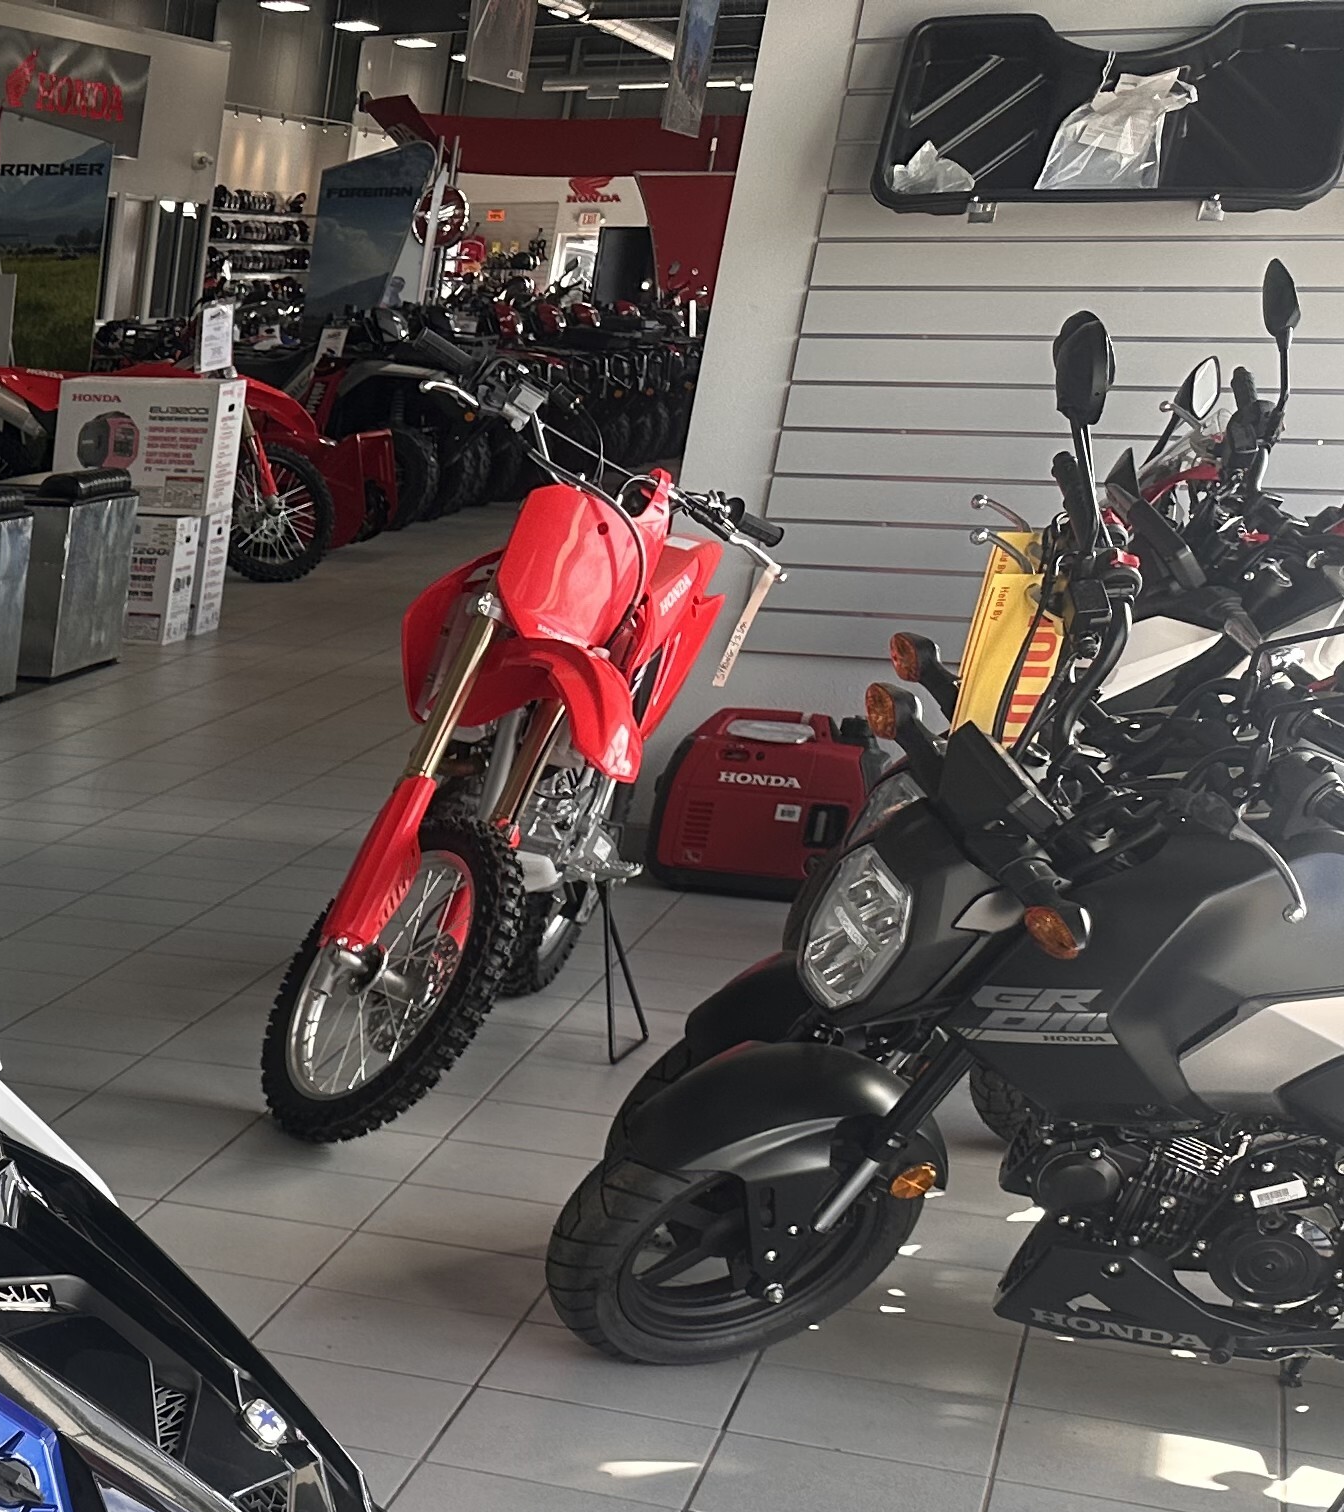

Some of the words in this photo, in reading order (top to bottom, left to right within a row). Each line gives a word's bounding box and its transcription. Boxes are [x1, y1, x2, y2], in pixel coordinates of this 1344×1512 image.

[35, 72, 125, 122] HONDA
[0, 162, 105, 177] RANCHER
[326, 186, 412, 199] FOREMAN
[566, 195, 621, 203] HONDA
[72, 393, 121, 402] HONDA
[659, 575, 693, 617] HONDA
[718, 770, 801, 789] HONDA
[1030, 1308, 1213, 1350] HONDA
